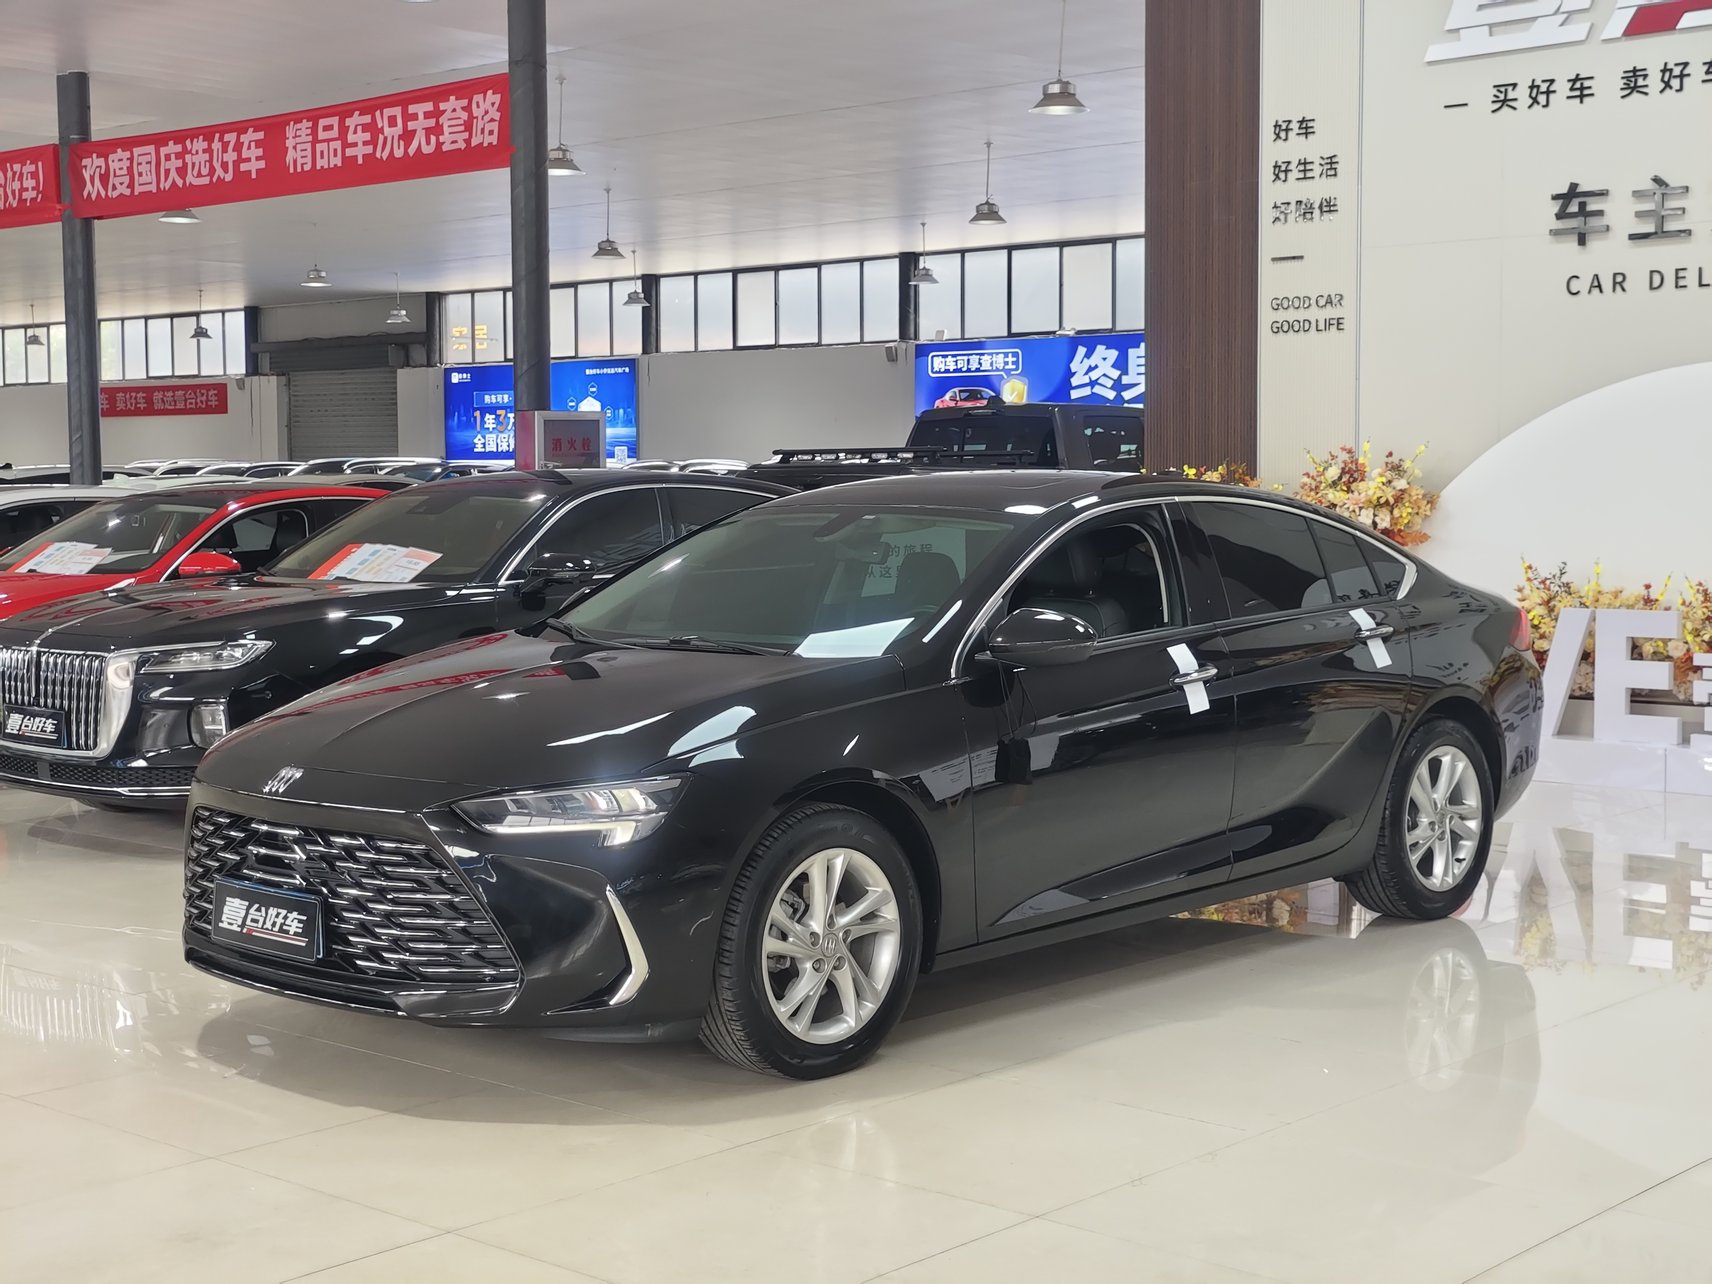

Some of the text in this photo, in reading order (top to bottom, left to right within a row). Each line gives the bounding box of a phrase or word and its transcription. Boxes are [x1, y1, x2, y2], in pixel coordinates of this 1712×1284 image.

[1490, 72, 1596, 114] 买好车
[1272, 116, 1316, 142] 好车
[81, 89, 502, 201] 欢度国庆选好车 精品车况无套路
[1272, 154, 1339, 183] 好生活
[0, 159, 44, 210] 好车!
[1271, 195, 1339, 224] 好陪伴
[1549, 174, 1693, 247] 车主
[1565, 266, 1711, 296] CAR DEL
[1270, 293, 1344, 311] GOOD CAR
[1270, 317, 1345, 334] GOOD LIFE
[932, 354, 1017, 372] 购车可享查博士
[153, 388, 219, 410] 就选壹台好车
[5, 713, 58, 734] 壹台好车
[218, 896, 308, 935] 壹台好车
